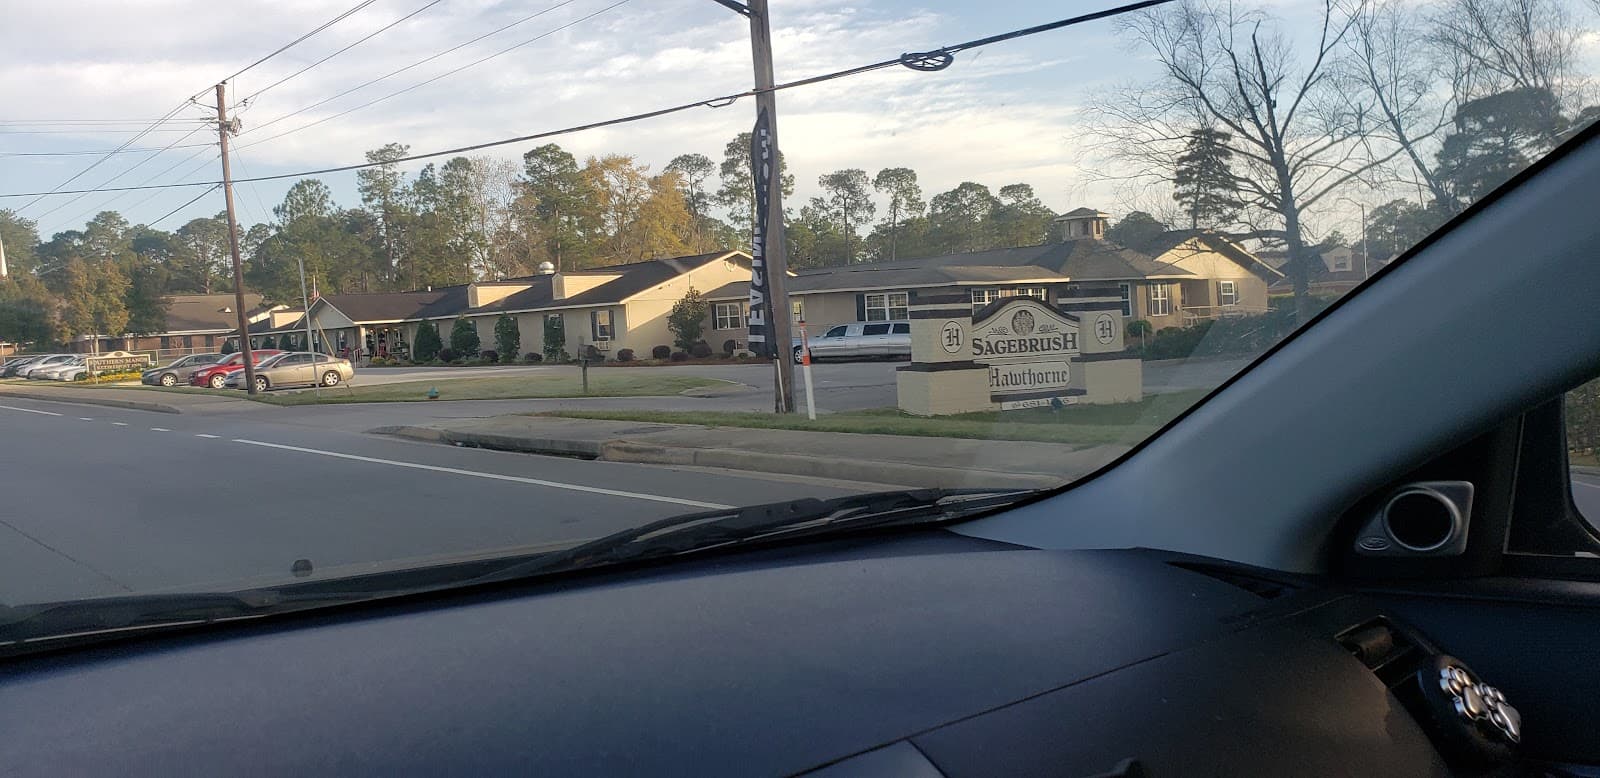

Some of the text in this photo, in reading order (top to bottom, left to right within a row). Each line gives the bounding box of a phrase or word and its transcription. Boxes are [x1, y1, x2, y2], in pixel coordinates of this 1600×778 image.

[943, 328, 961, 347] H
[1099, 320, 1114, 339] H
[972, 332, 1078, 356] SAGEBRUSH
[990, 366, 1068, 388] Hawthorne
